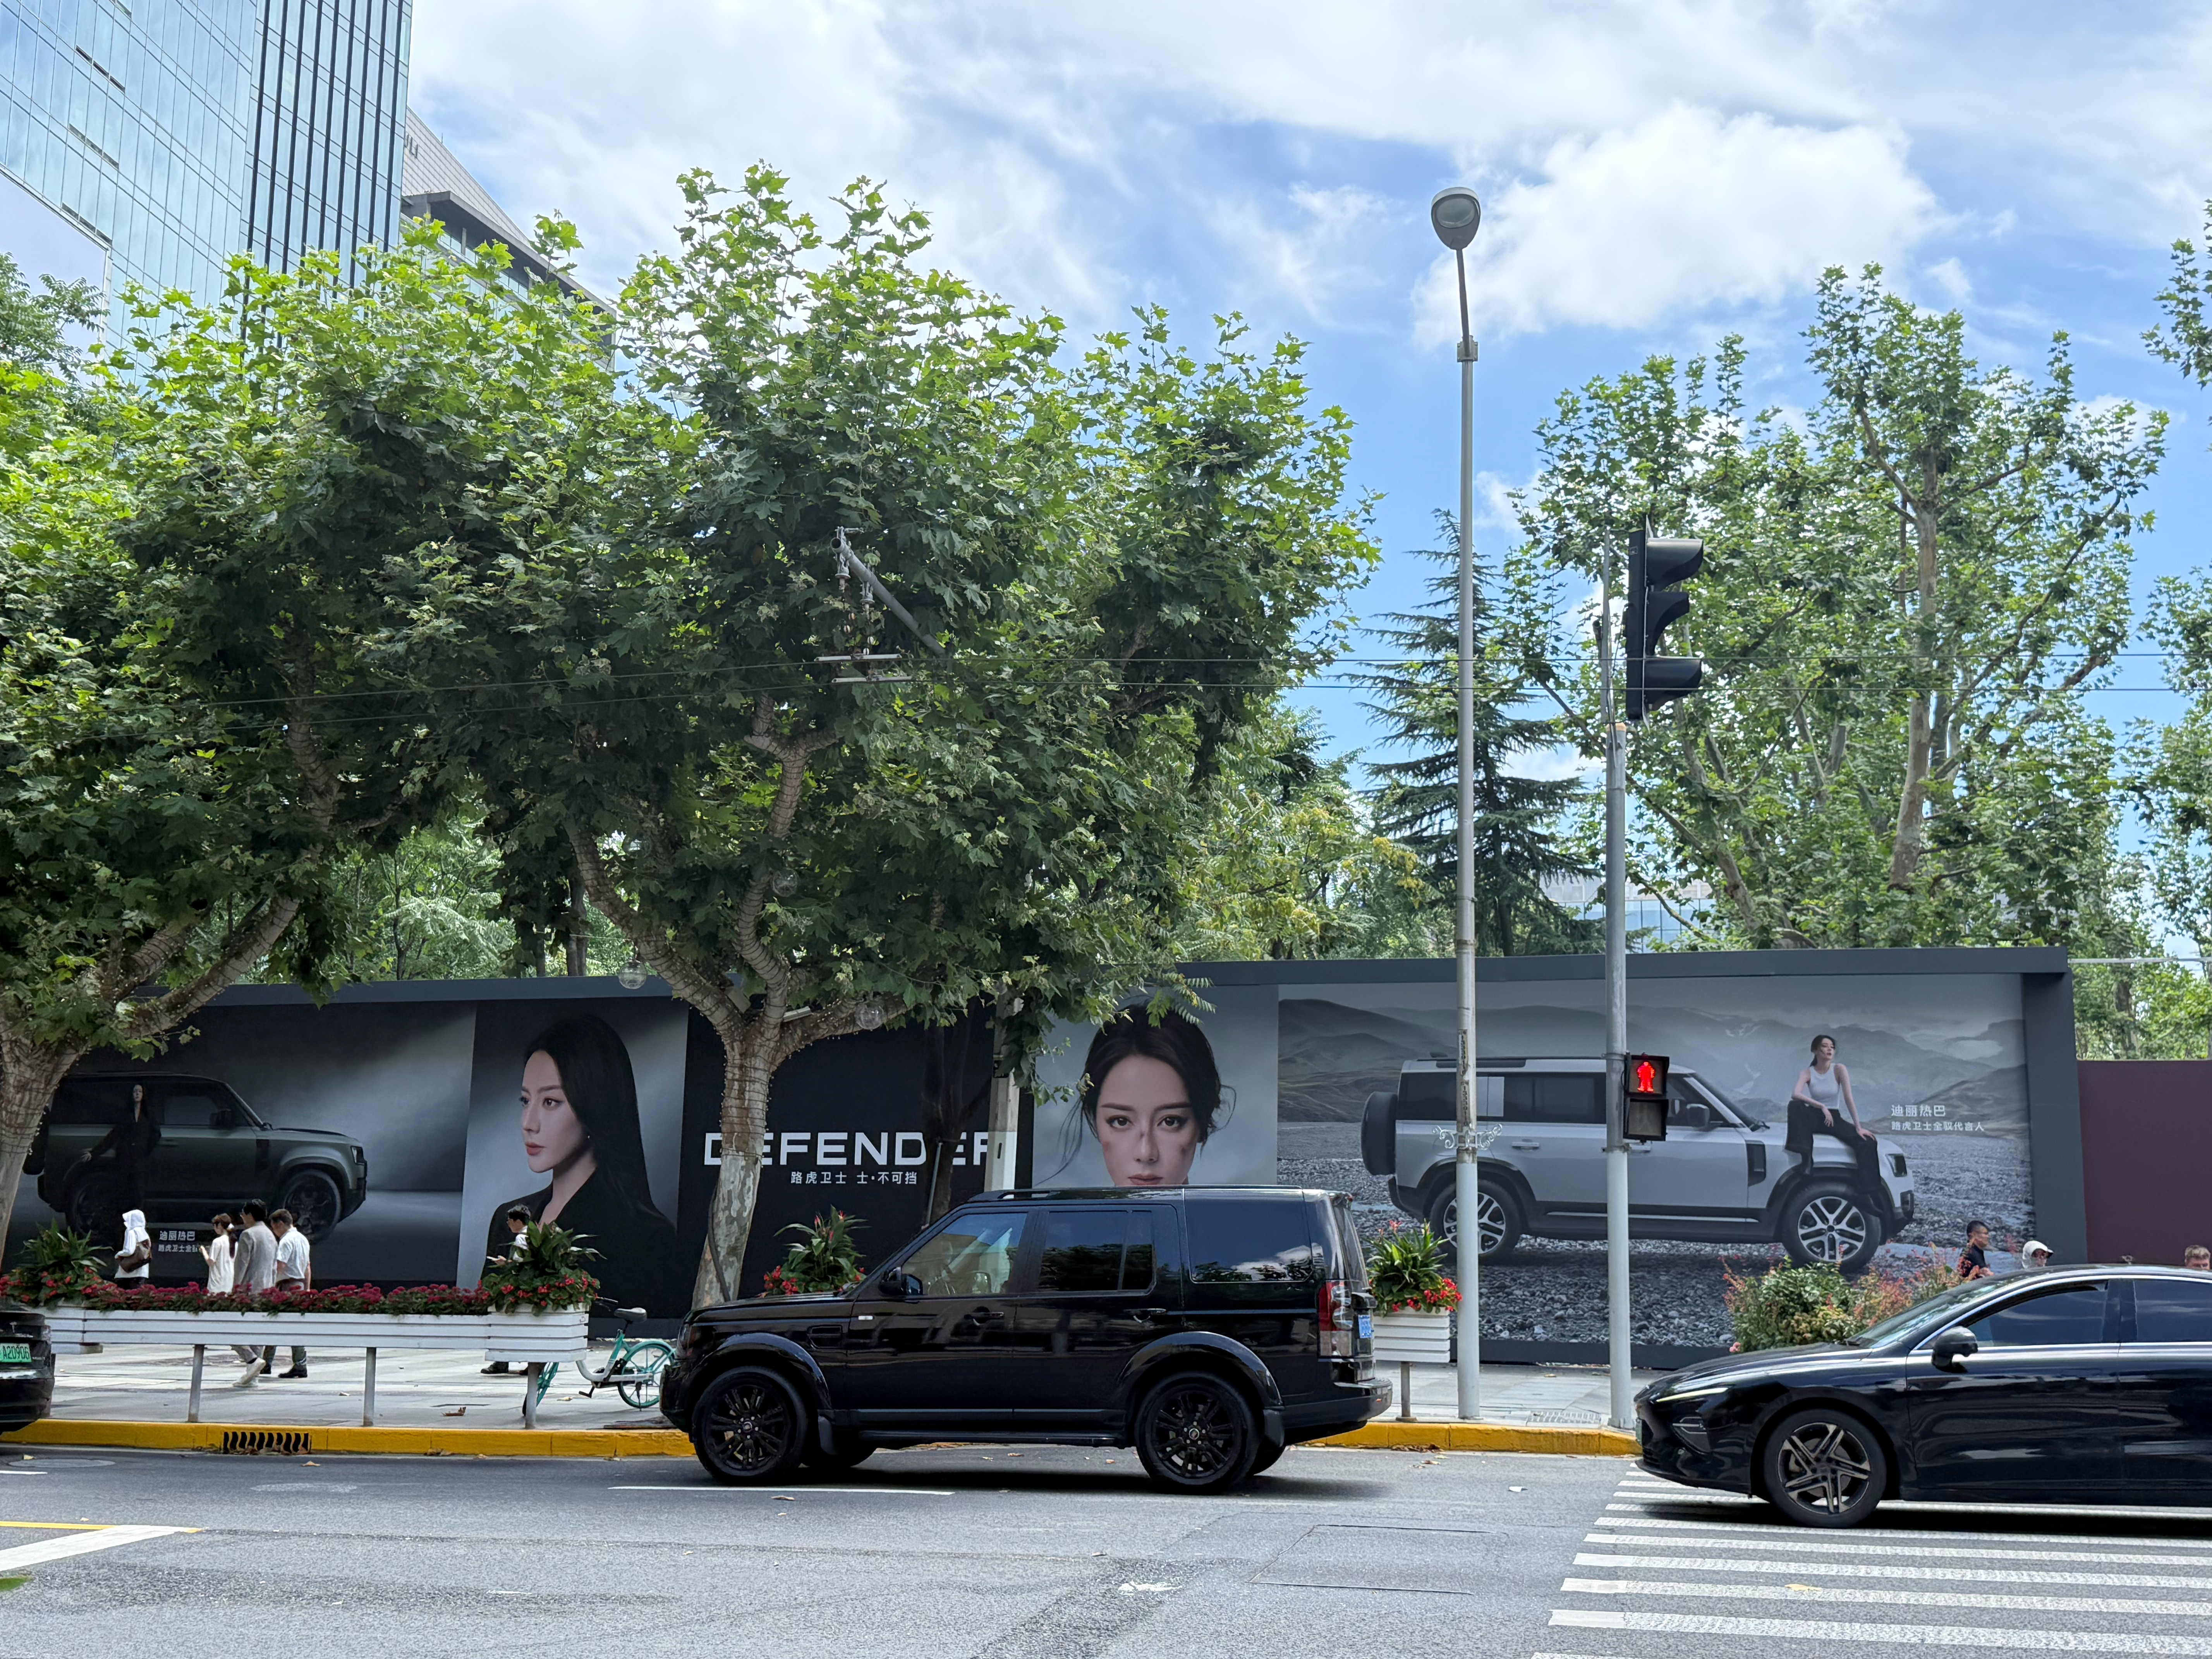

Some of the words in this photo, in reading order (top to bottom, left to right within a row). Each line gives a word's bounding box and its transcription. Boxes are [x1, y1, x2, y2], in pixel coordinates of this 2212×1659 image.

[1891, 1104, 1946, 1116] 迪丽热巴
[791, 1171, 847, 1184] 路虎卫士
[857, 1171, 917, 1184] 士·不可挡
